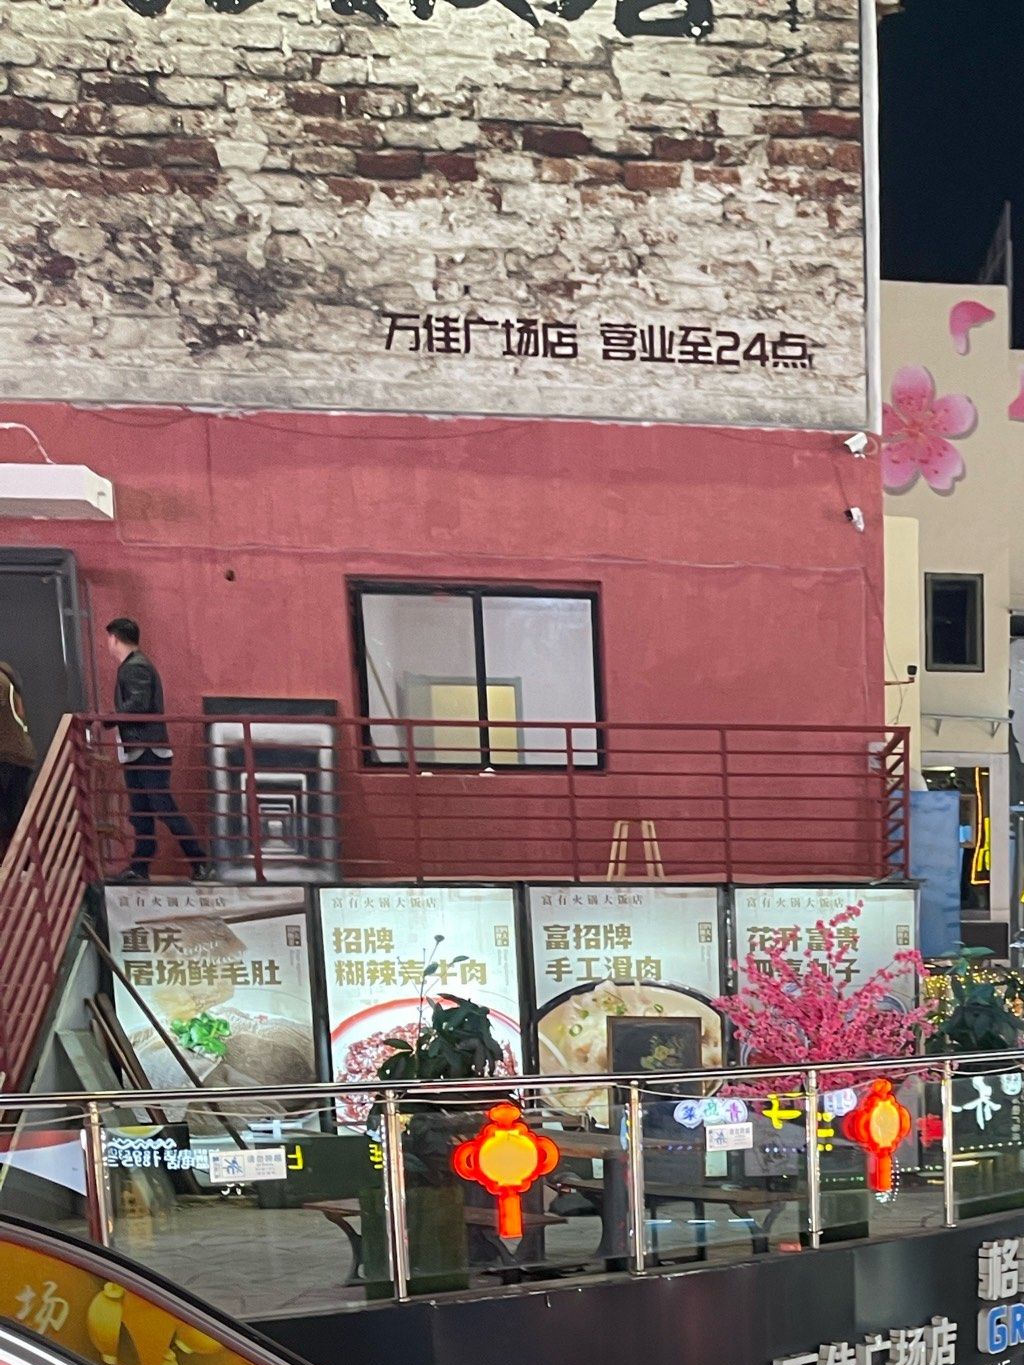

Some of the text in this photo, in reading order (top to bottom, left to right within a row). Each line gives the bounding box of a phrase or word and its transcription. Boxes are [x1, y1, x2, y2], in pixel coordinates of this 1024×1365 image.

[383, 313, 812, 370] 万佳广场店 营业至24点
[121, 927, 184, 954] 重庆
[332, 927, 395, 954] 招牌
[542, 923, 633, 952] 富招牌
[746, 926, 860, 952] 花开富贵
[544, 955, 663, 982] 手工滑肉
